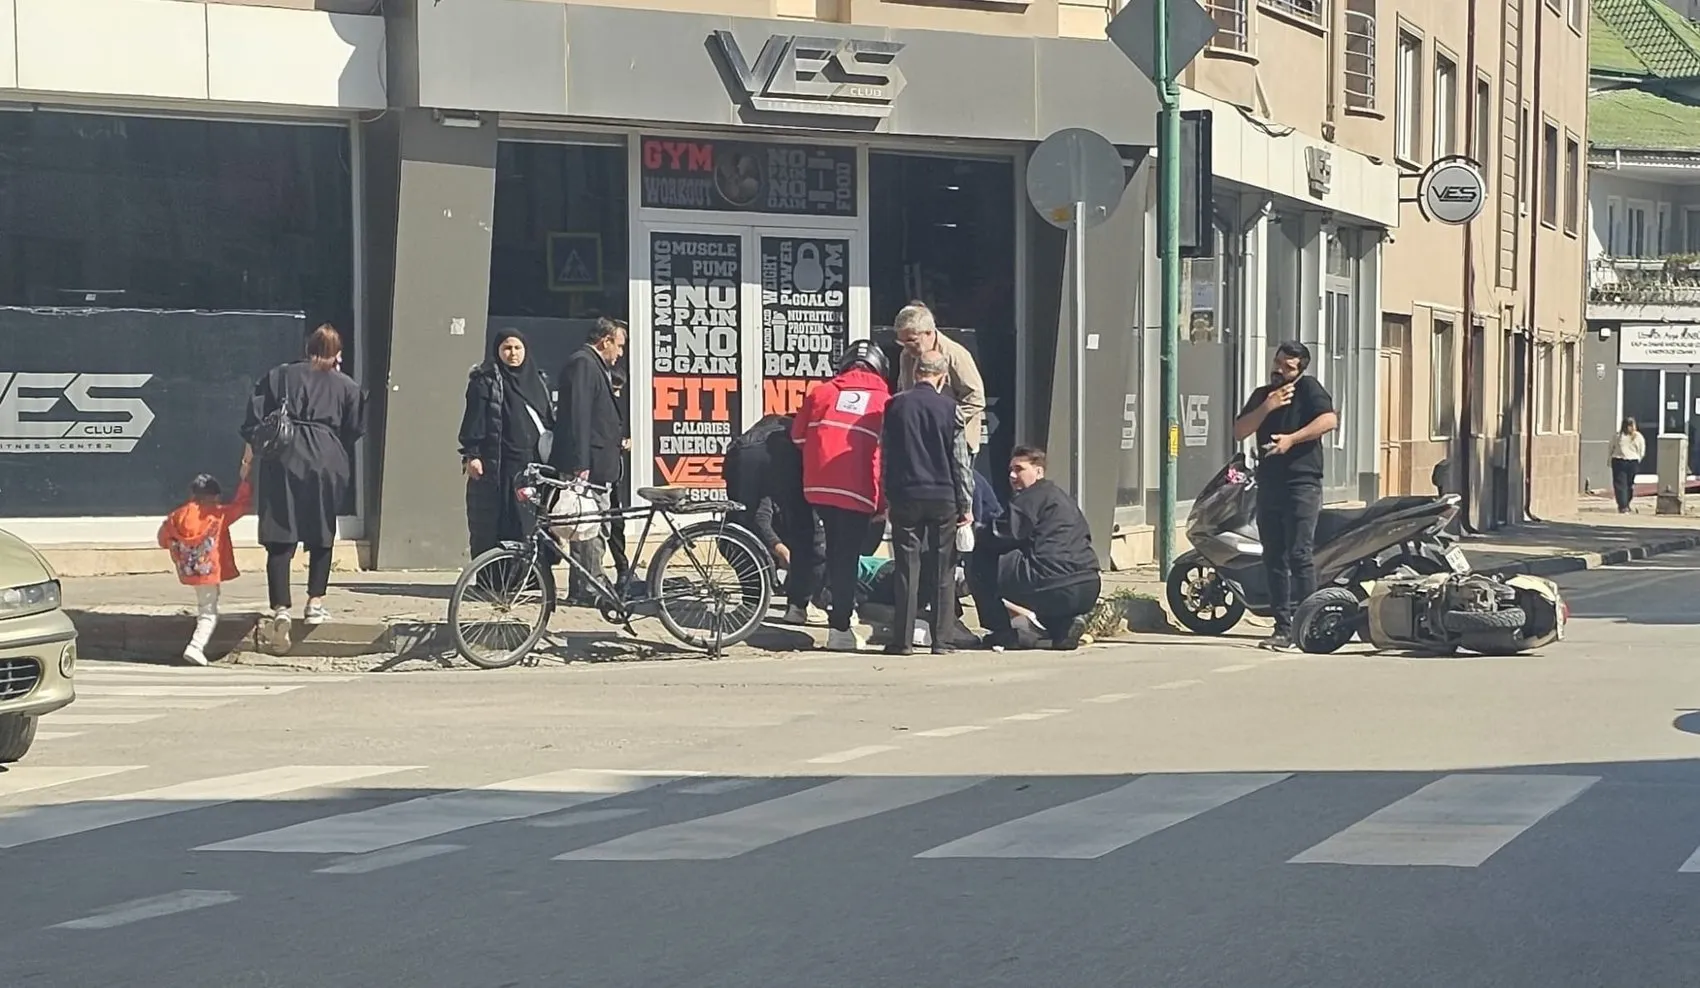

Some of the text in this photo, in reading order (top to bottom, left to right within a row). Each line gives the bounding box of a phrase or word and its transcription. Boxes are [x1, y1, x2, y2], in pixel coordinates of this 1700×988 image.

[704, 30, 907, 104] VES
[850, 87, 882, 97] CLUB
[643, 140, 714, 171] GYM
[767, 148, 806, 168] NO
[767, 167, 806, 179] PAIN
[644, 176, 713, 207] WORKOUT
[767, 180, 806, 198] NO
[836, 161, 851, 211] FOOD
[1431, 186, 1477, 202] VES
[767, 196, 806, 210] GAIN
[672, 241, 737, 257] MUSCLE
[692, 260, 738, 277] PUMP
[780, 241, 793, 306] POWER
[825, 243, 844, 307] GYM
[762, 254, 778, 306] WEIGHT
[674, 277, 738, 309] NO
[792, 293, 825, 307] GOAL
[654, 240, 672, 373] GET MOVING
[674, 308, 738, 326] PAIN
[787, 310, 844, 323] NUTRITION
[787, 322, 825, 335] PROTEIN
[674, 326, 738, 356] NO
[787, 334, 833, 352] FOOD
[674, 357, 737, 374] GAIN
[764, 353, 833, 377] BCAA
[0, 372, 155, 439] ES
[653, 377, 738, 420] FIT
[1180, 394, 1210, 437] VES
[84, 425, 123, 435] CLUB
[673, 422, 731, 435] CALORIES
[659, 436, 732, 455] ENERGY
[655, 456, 726, 482] VES
